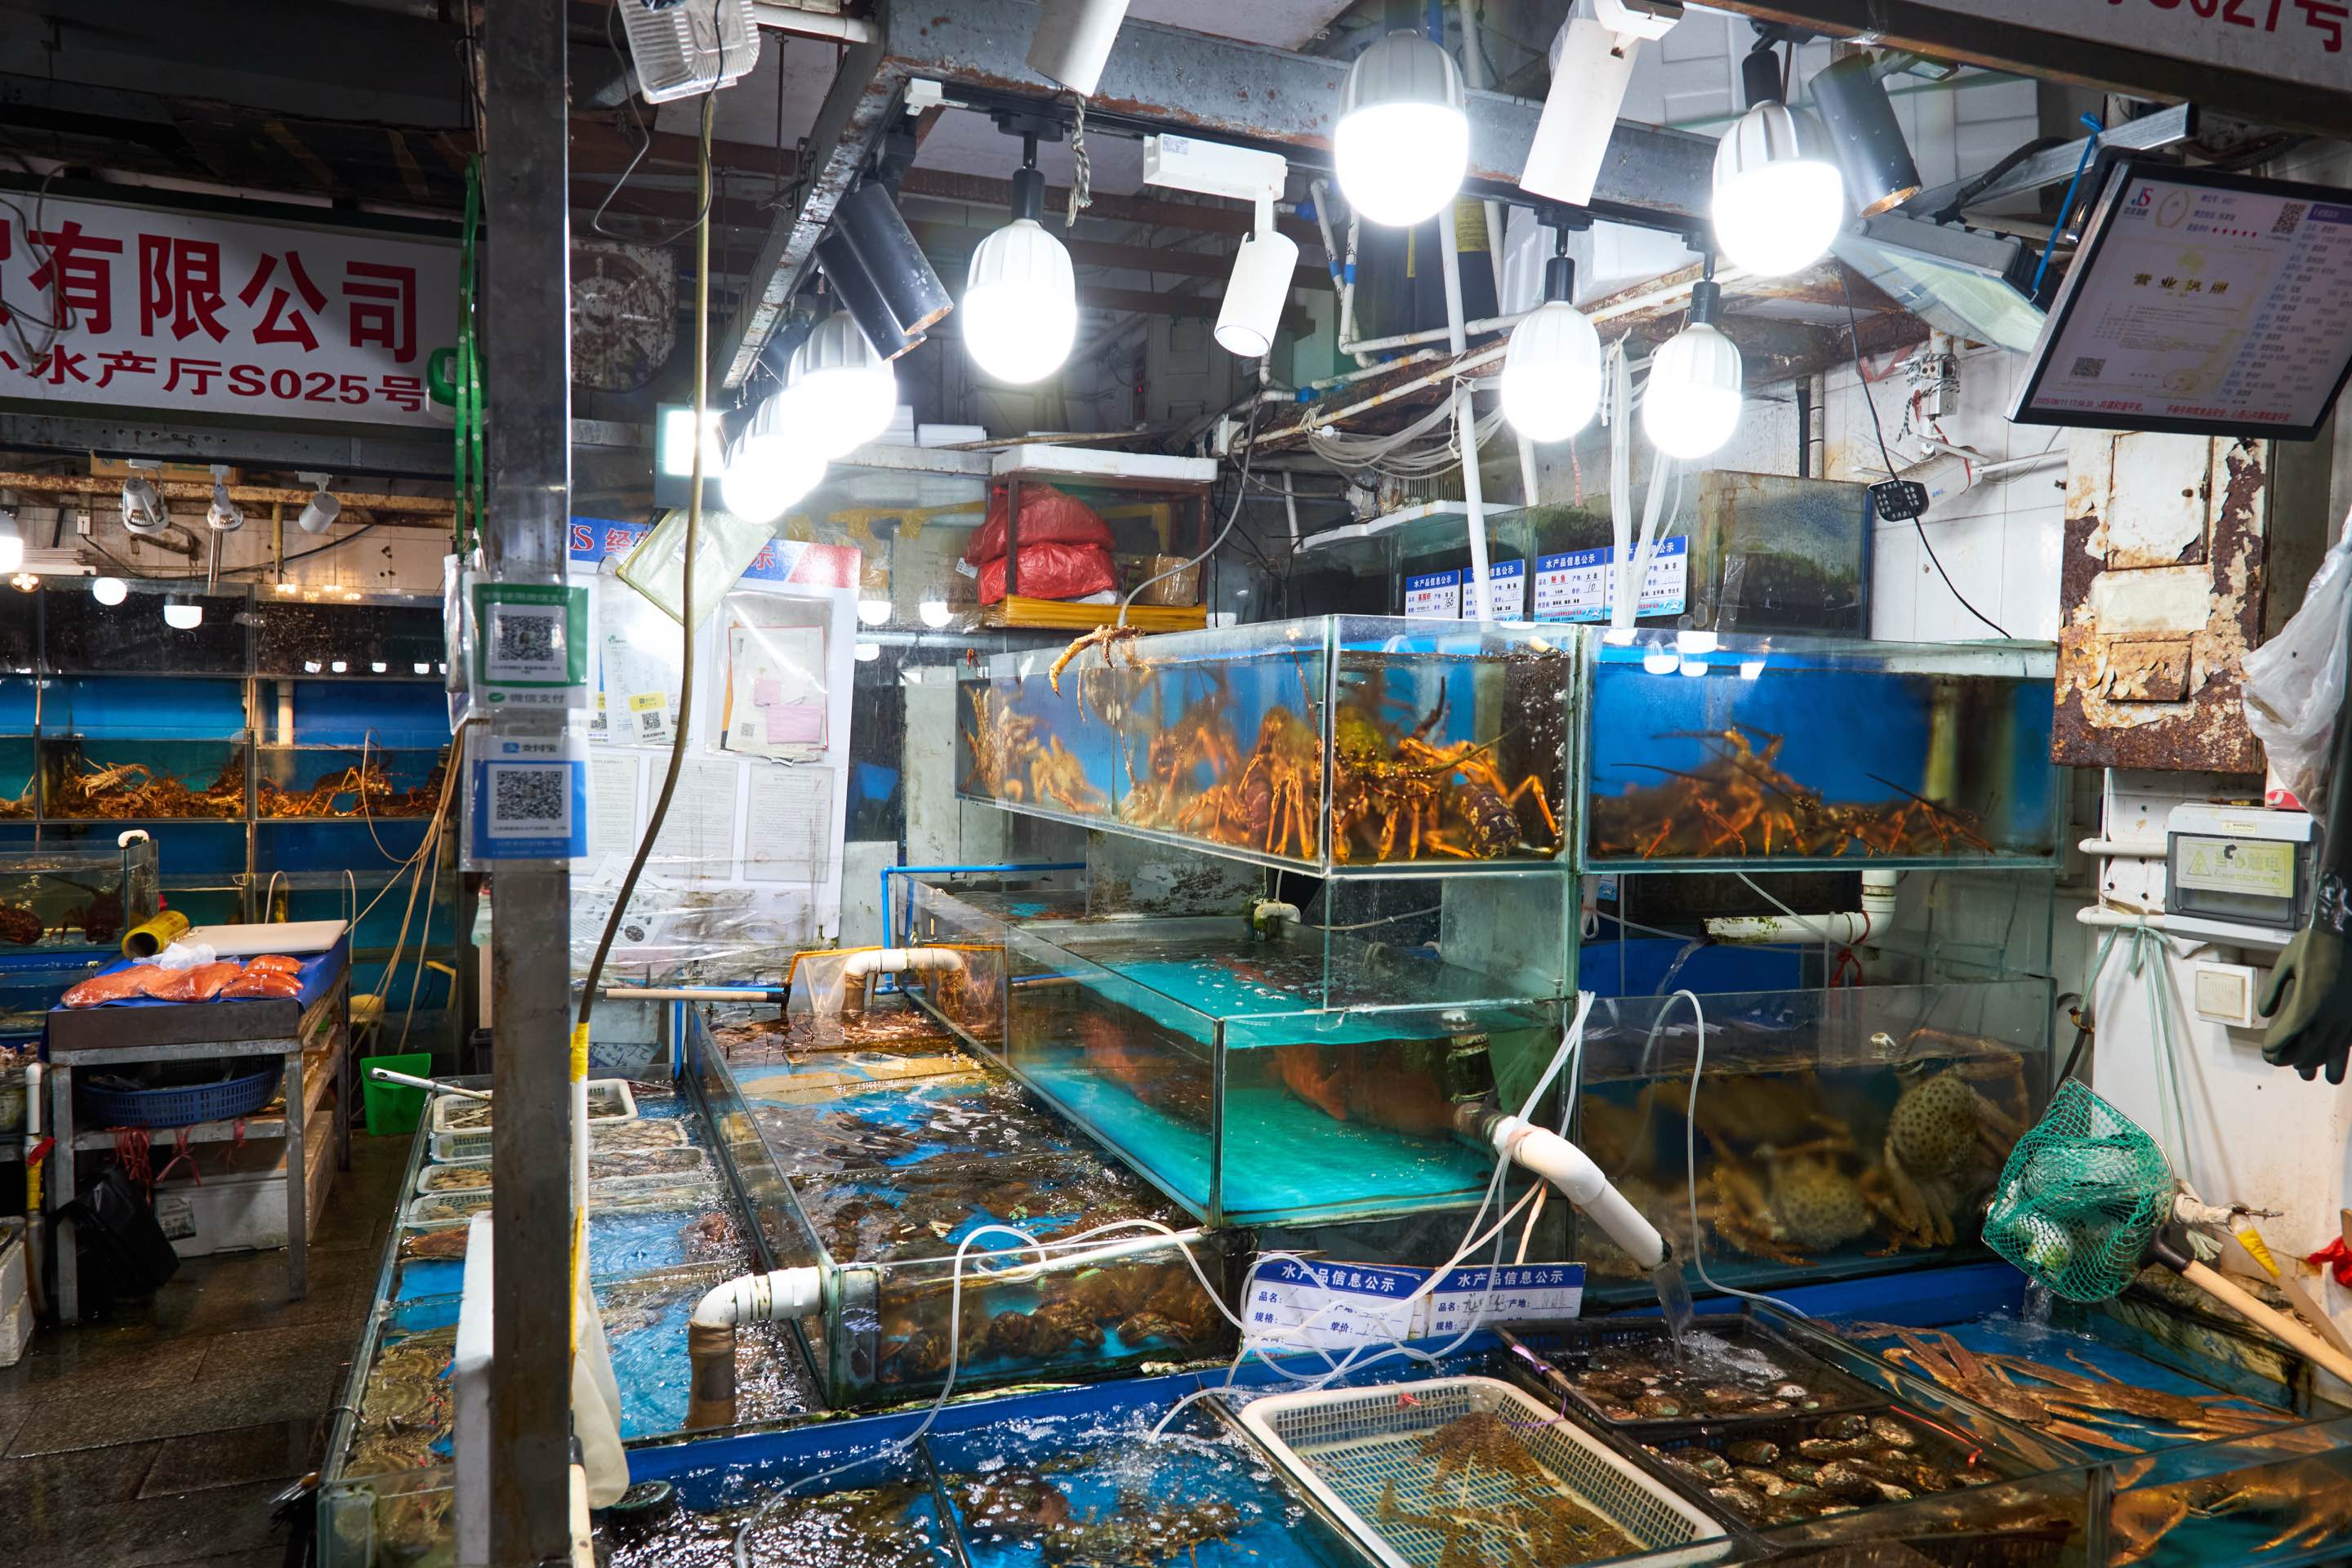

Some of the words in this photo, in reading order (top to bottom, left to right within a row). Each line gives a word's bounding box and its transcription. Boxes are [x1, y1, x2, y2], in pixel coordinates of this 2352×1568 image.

[0, 219, 416, 364] 有限公司
[1546, 554, 1596, 568] 水产品信息公示
[1414, 575, 1452, 589] 水产品信息公示
[510, 693, 565, 704] 微信支付
[522, 744, 557, 753] 支付宝
[1281, 1263, 1396, 1293] 水产品信息公示
[1458, 1270, 1564, 1288] 水产品信息公示
